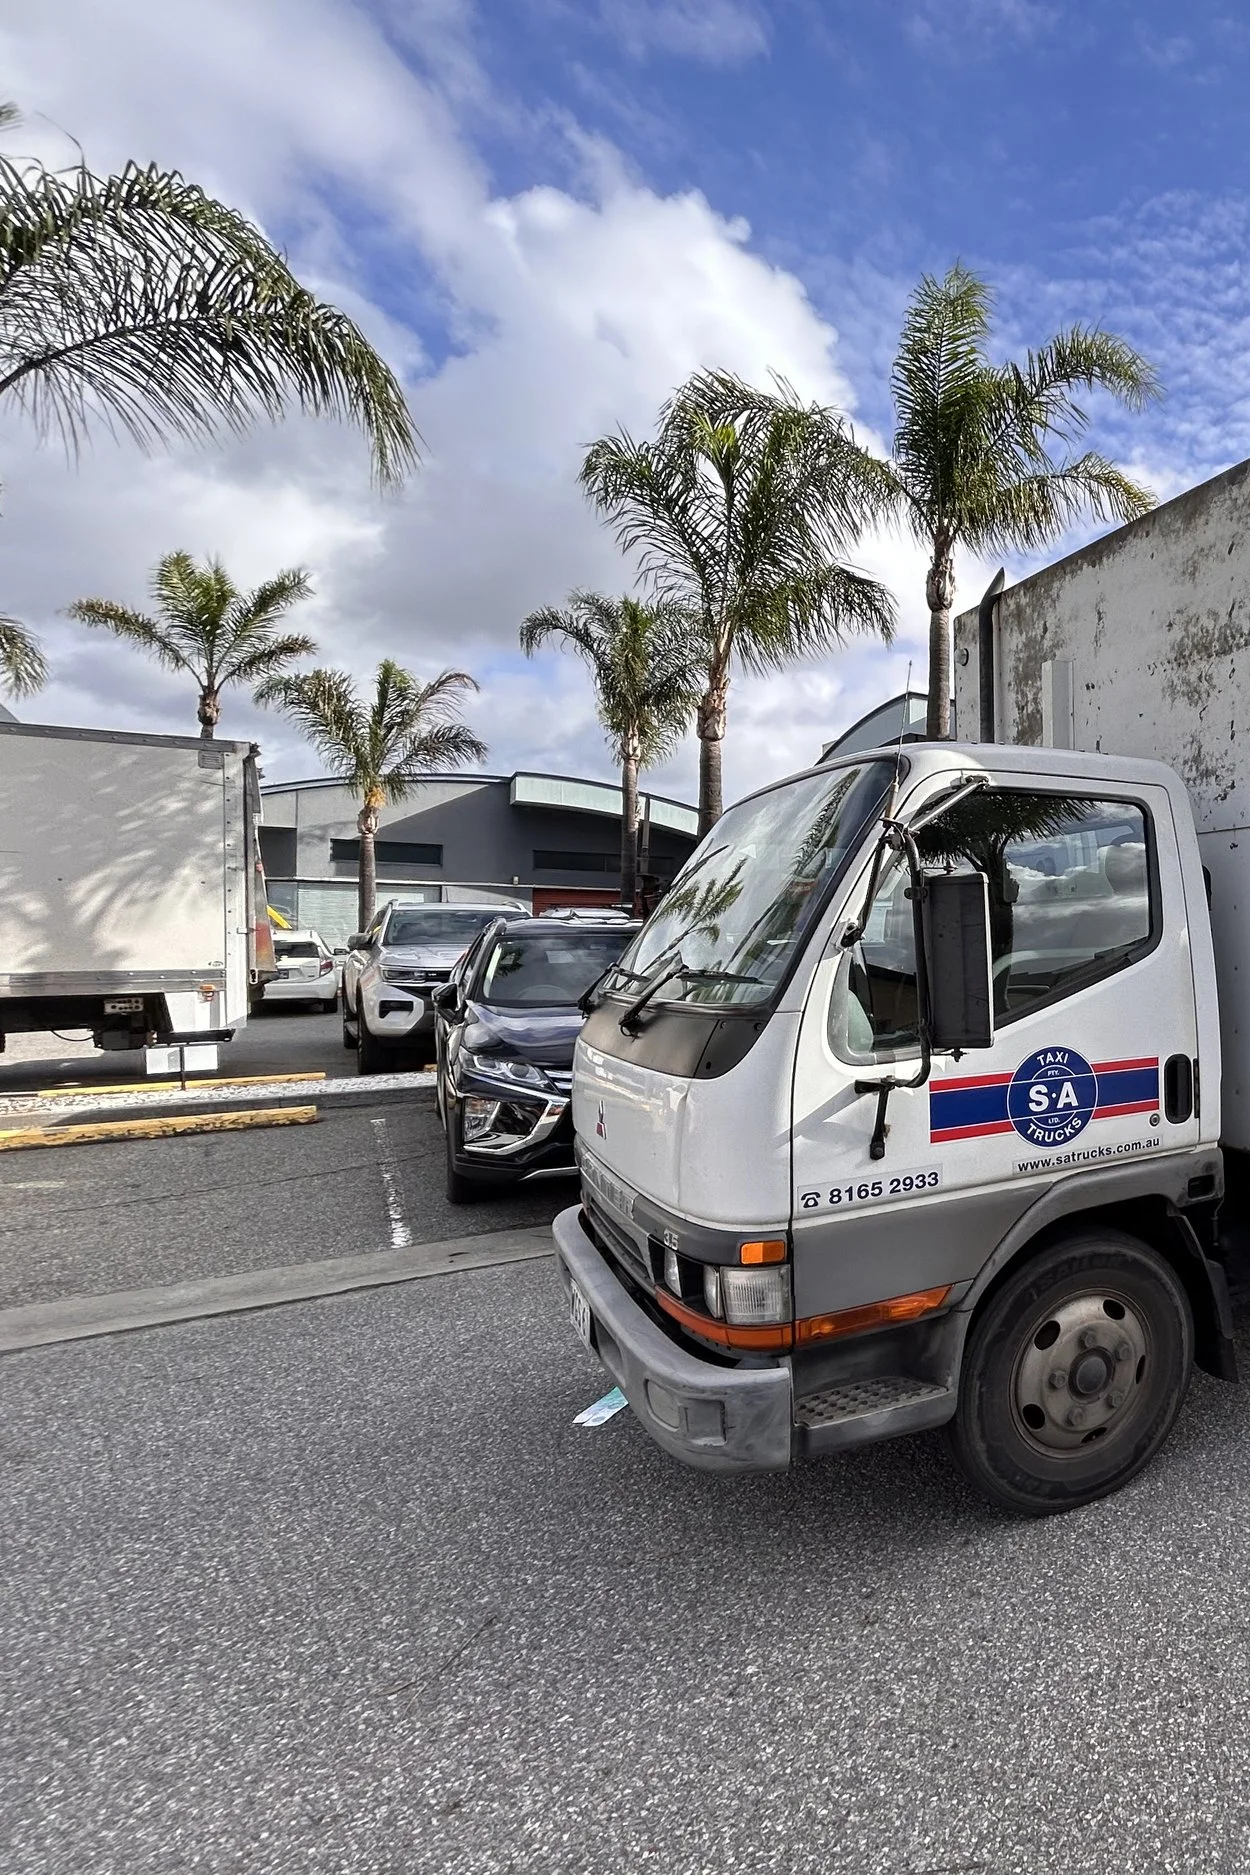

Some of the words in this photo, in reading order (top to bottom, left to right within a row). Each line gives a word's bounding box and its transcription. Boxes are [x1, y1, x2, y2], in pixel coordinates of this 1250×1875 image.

[1036, 1051, 1069, 1066] TAXI
[1026, 1117, 1082, 1143] TRUCKS
[1018, 1138, 1160, 1172] www.satrucks.com.au
[828, 1181, 882, 1204] 8165
[889, 1172, 939, 1194] 2933
